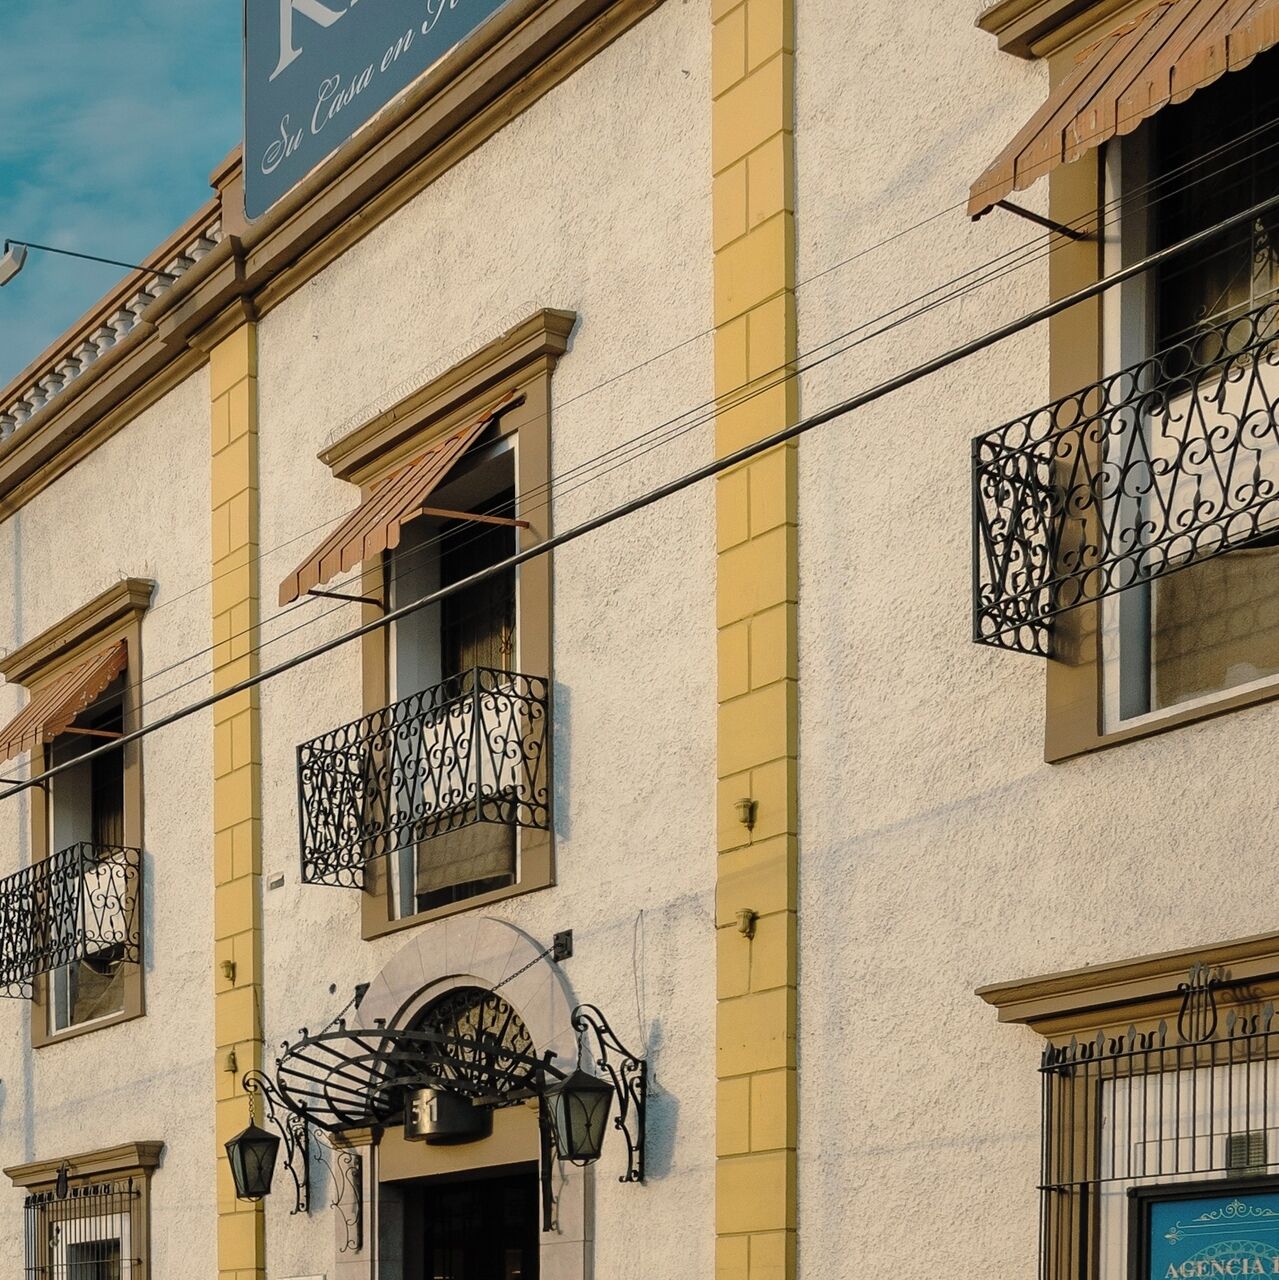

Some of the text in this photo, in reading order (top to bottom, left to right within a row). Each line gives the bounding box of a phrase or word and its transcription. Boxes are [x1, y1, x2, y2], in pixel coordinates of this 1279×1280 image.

[261, 113, 304, 174] Su
[310, 73, 375, 135] Casa
[380, 28, 416, 72] en
[1165, 1257, 1264, 1279] AGENCIA
